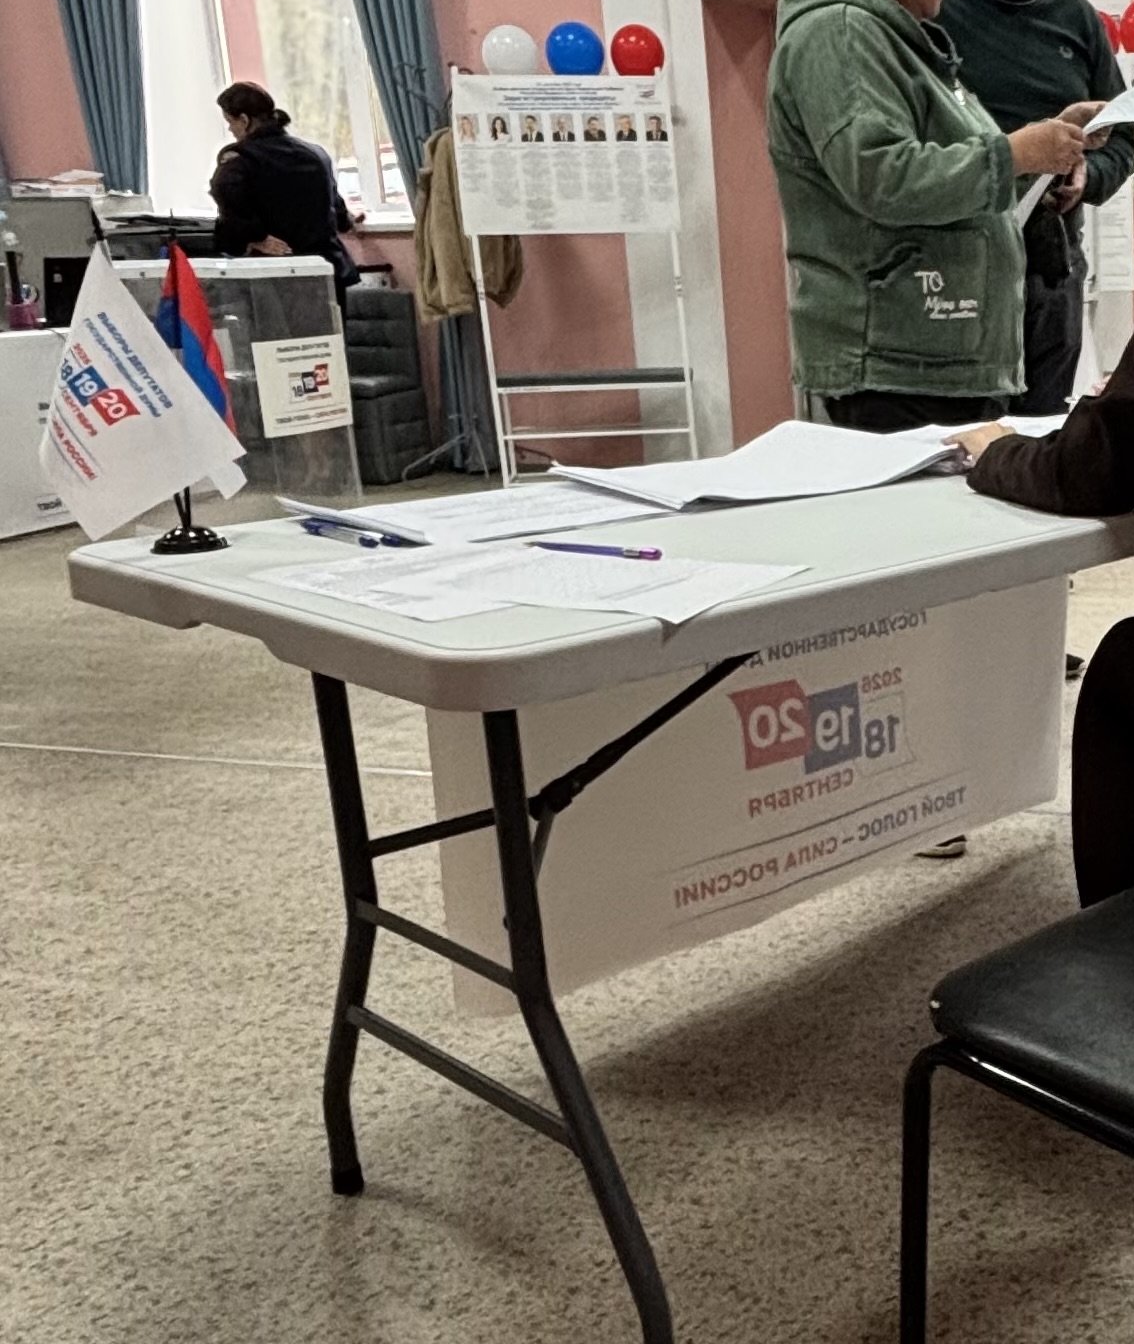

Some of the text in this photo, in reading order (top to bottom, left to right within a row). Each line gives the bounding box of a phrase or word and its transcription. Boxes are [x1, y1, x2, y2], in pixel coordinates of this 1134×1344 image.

[97, 311, 174, 409] ВЫБОРЫ ДЕПУТАТОВ
[73, 373, 98, 397] 19
[97, 392, 128, 420] 20
